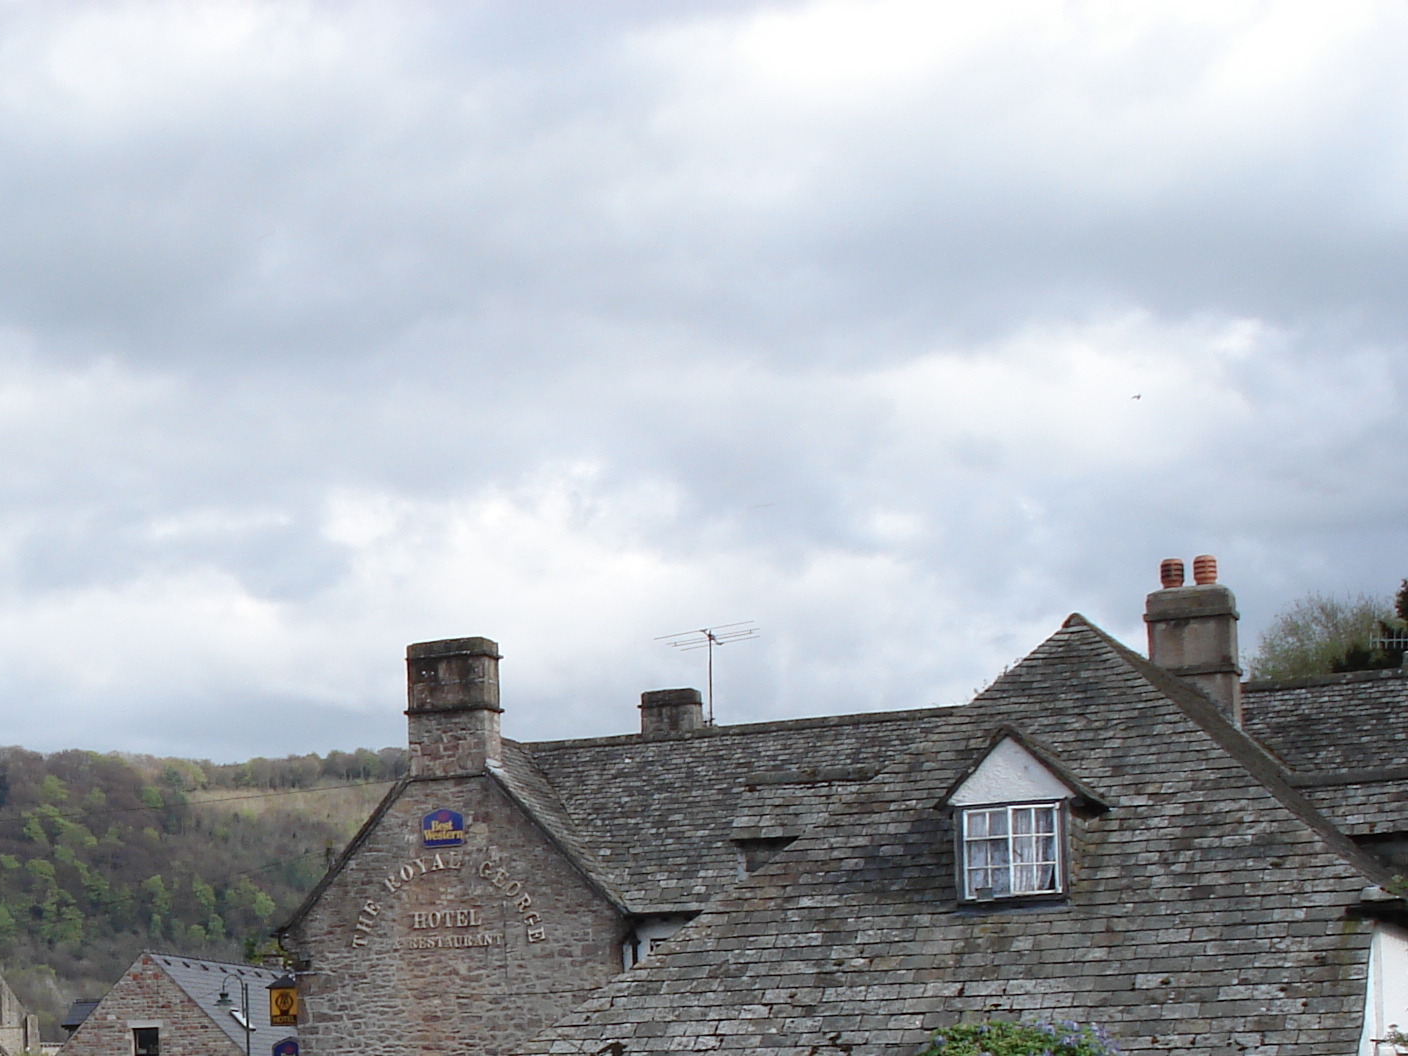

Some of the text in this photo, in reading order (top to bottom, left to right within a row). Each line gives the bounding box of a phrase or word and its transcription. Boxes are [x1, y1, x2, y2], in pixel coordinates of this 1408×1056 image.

[431, 820, 453, 831] Best
[423, 829, 465, 841] Western
[352, 851, 546, 949] THE ROYAL GEORGE
[412, 909, 482, 929] HOTEL
[409, 934, 503, 949] RESTAURANT
